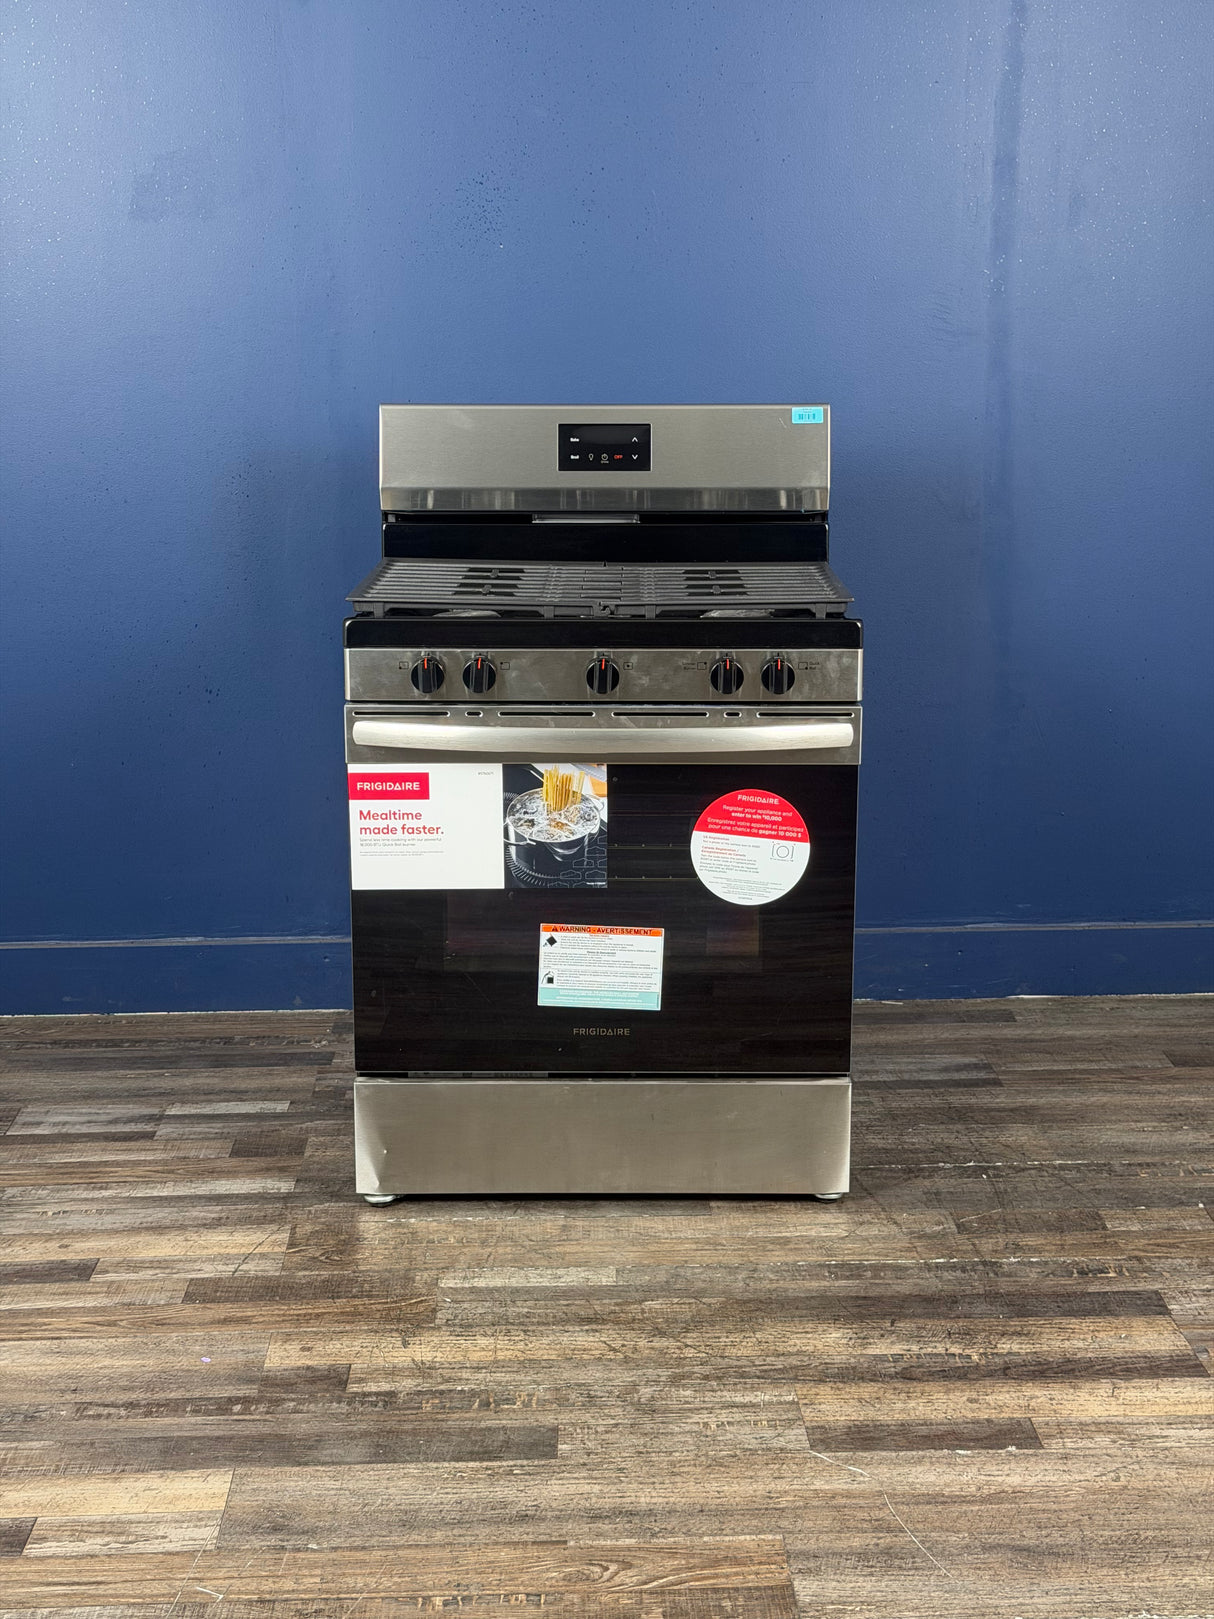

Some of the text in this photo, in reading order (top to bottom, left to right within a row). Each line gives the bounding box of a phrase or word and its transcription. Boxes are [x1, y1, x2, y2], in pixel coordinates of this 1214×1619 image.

[357, 782, 420, 790] FRIGIDAIRE
[738, 795, 779, 804] FRIGIDAIRE
[359, 810, 422, 820] Mealtime
[359, 824, 444, 835] made faster.
[707, 817, 736, 826] Enregistrez
[751, 822, 772, 830] appareil
[779, 825, 804, 833] participez
[597, 928, 652, 936] AVERTISSEMENT
[573, 1028, 631, 1036] FRIGIDAIRE
